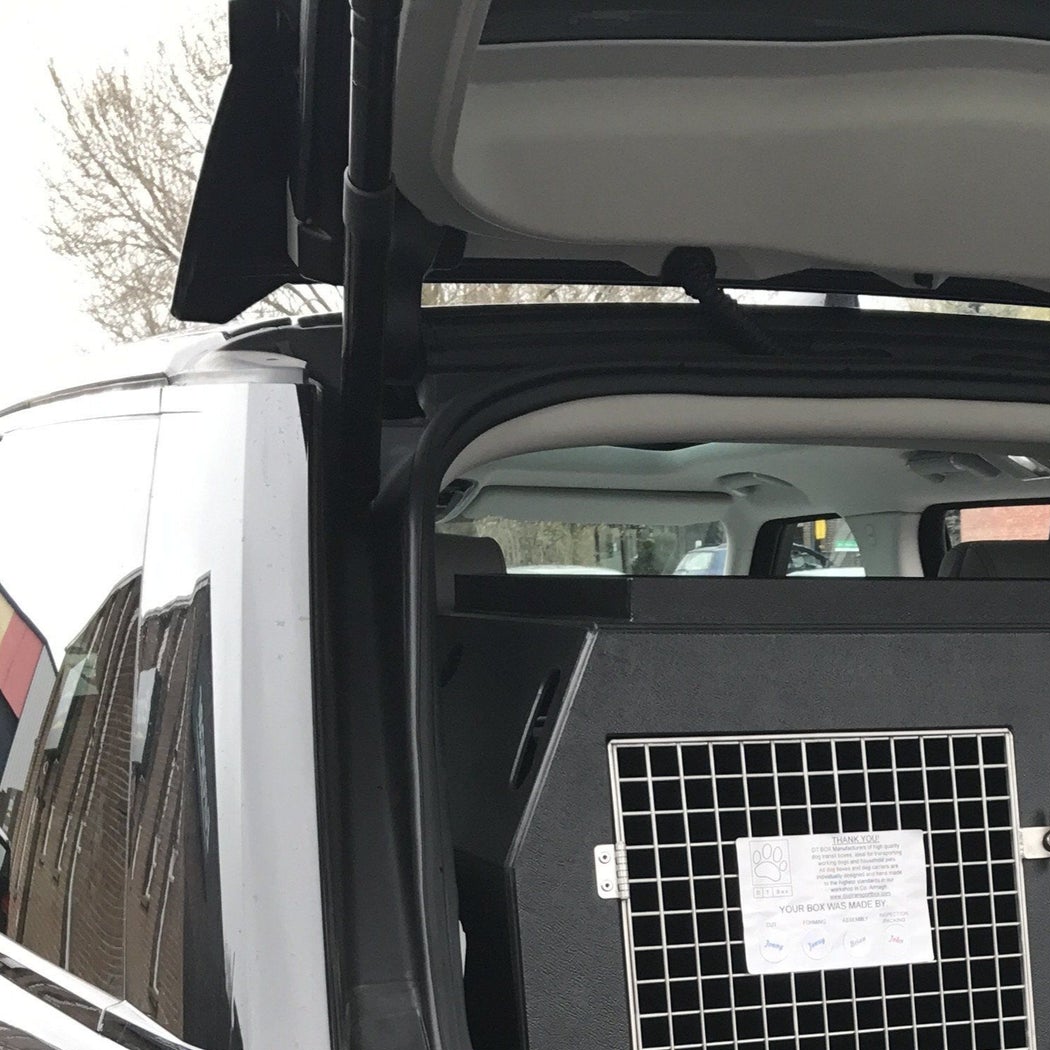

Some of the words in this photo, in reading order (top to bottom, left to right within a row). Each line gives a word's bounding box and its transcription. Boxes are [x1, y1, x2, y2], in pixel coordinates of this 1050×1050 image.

[832, 835, 859, 845] THANK
[861, 834, 880, 844] YOU!
[779, 904, 804, 914] YOUR
[807, 903, 825, 912] BOX
[827, 901, 847, 911] WAS
[848, 899, 872, 909] MADE
